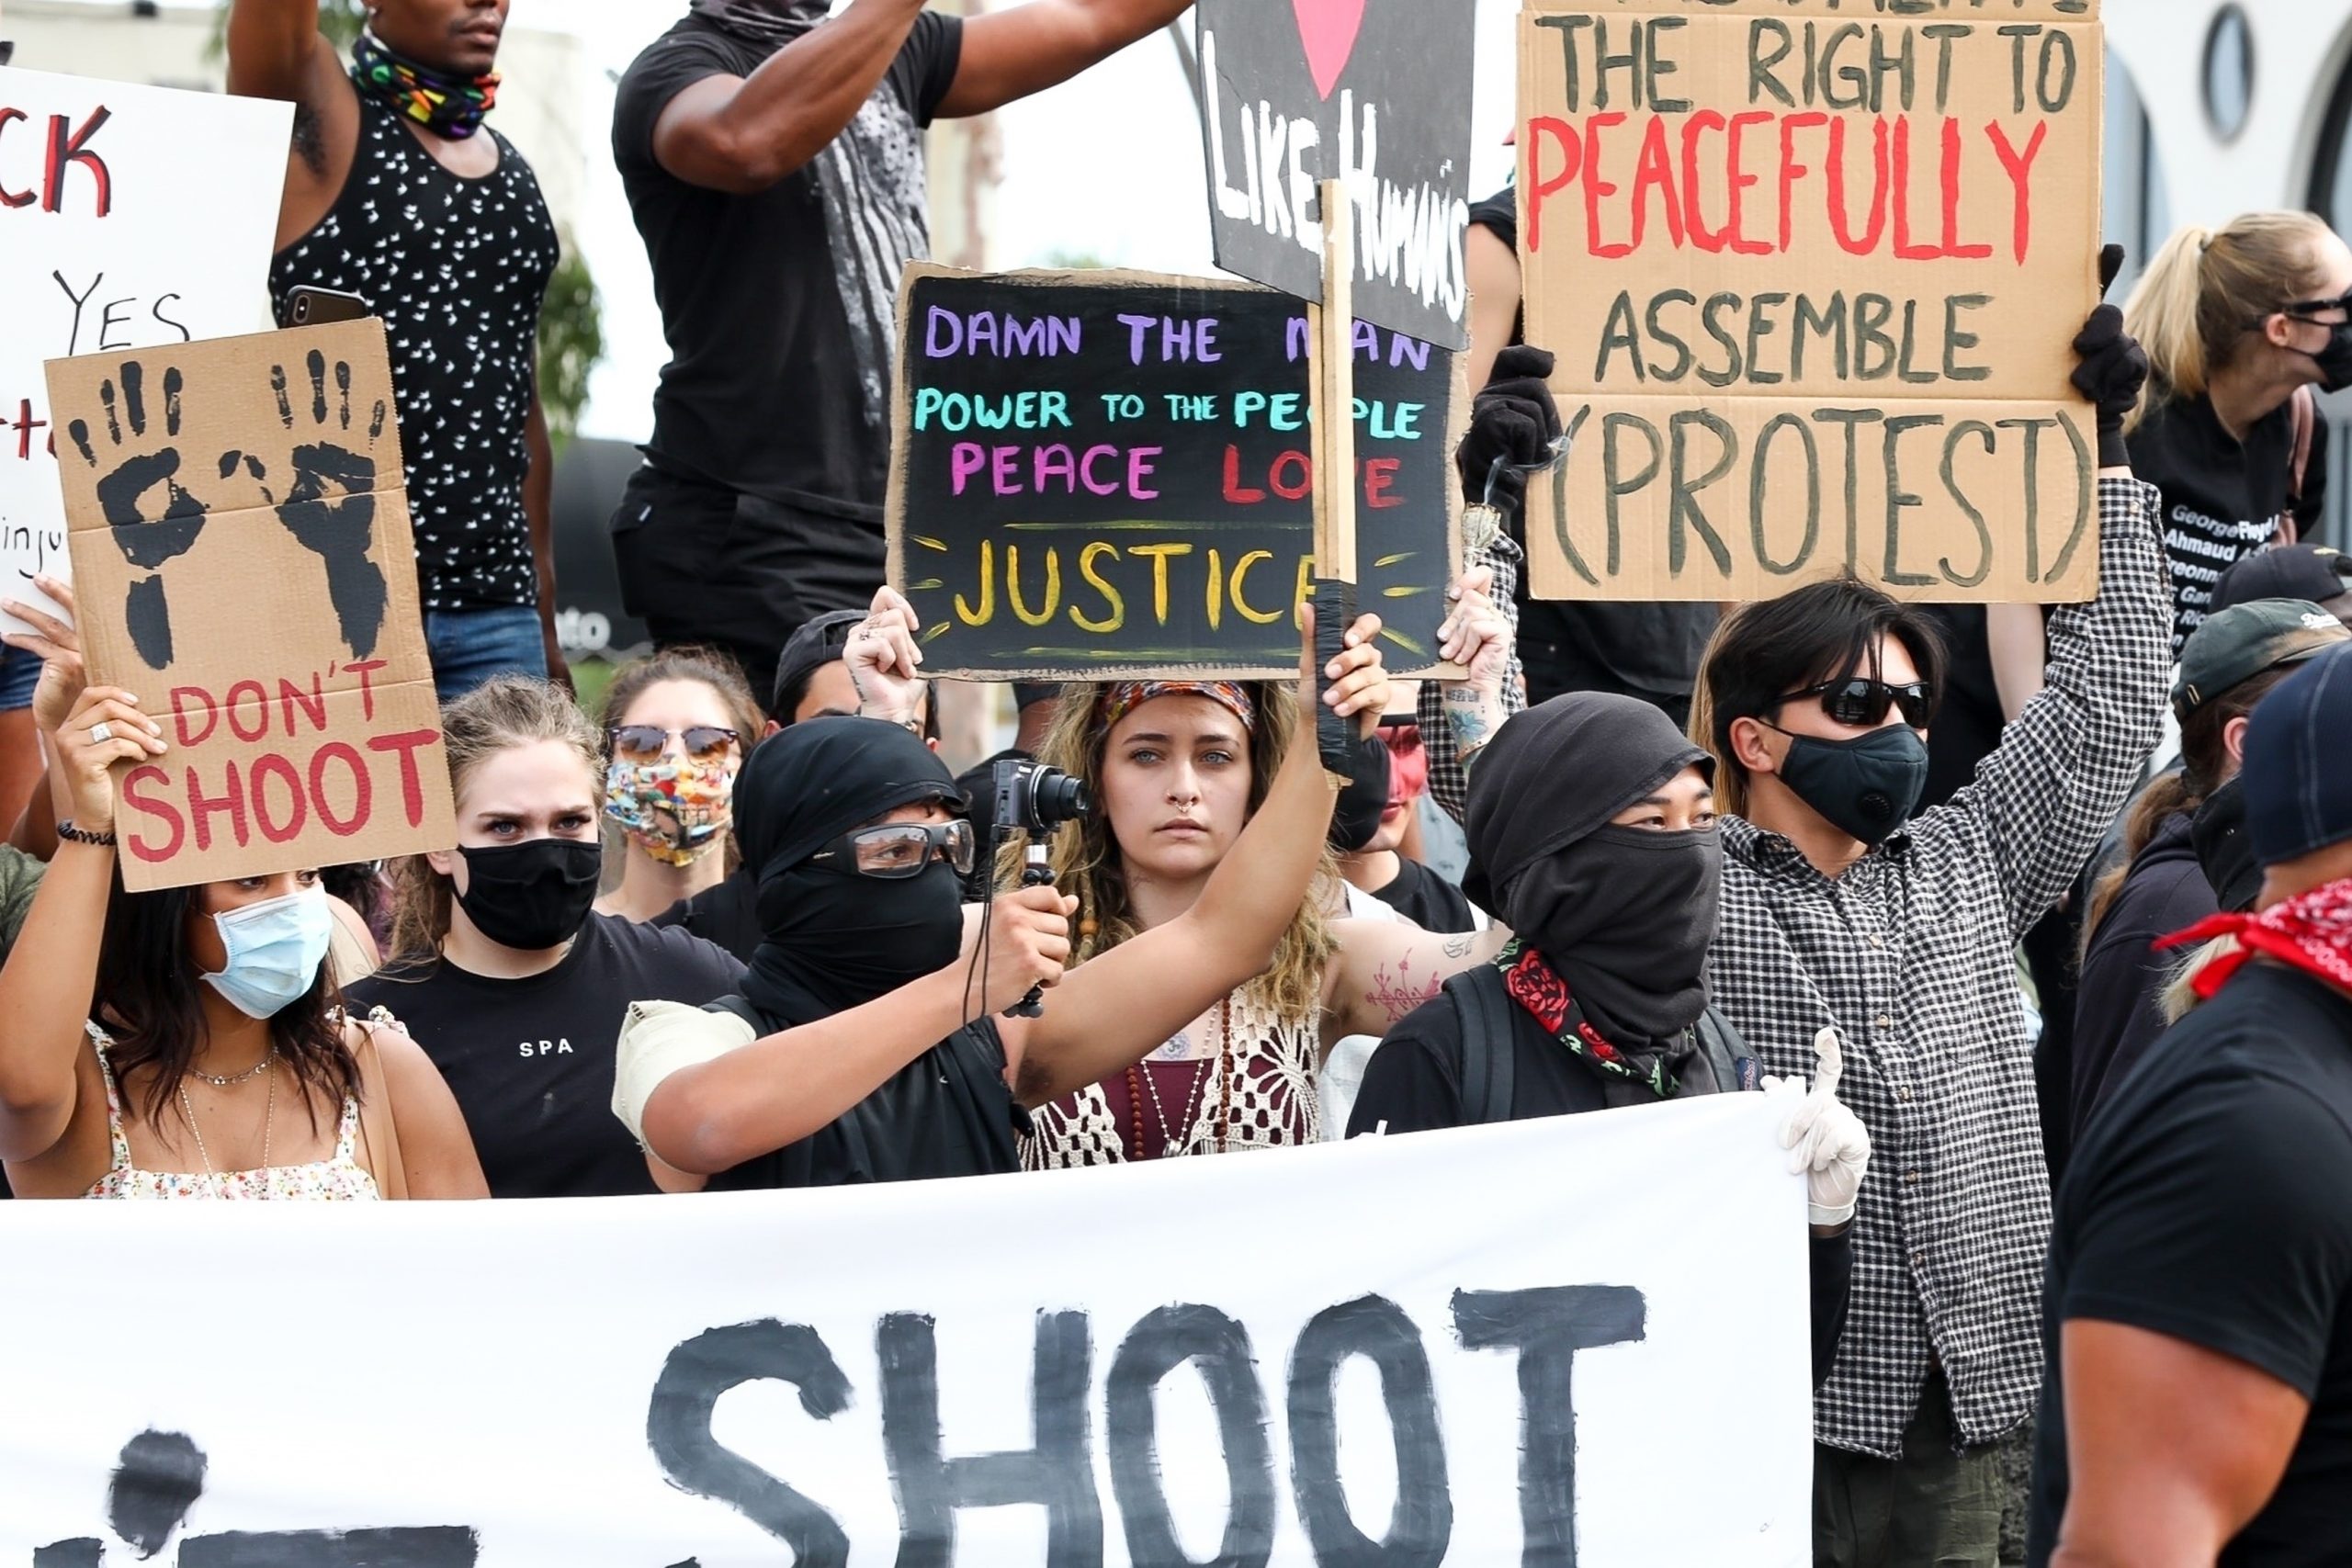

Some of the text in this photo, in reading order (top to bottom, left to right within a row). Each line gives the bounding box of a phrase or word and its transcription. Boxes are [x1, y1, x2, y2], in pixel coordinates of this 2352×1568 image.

[1535, 16, 2075, 113] THE RIGHT TO
[1203, 30, 1324, 266] LIKE
[1528, 109, 2047, 265] PEACEFULLY
[52, 270, 190, 356] YES
[925, 306, 1080, 358] DAMN
[1116, 313, 1222, 366] THE
[1594, 288, 1995, 386] ASSEMBLE
[915, 388, 1426, 439] POWER TO THE PEPLE
[952, 442, 1406, 508] PEACE LOE
[1553, 405, 2090, 586] (PROTEST)
[2165, 528, 2238, 561] Ahmaud
[2171, 505, 2238, 537] George
[170, 660, 388, 747] DON'T
[122, 729, 441, 863] SHOOT
[519, 1038, 573, 1057] SPA
[647, 1284, 1647, 1568] SHOOT
